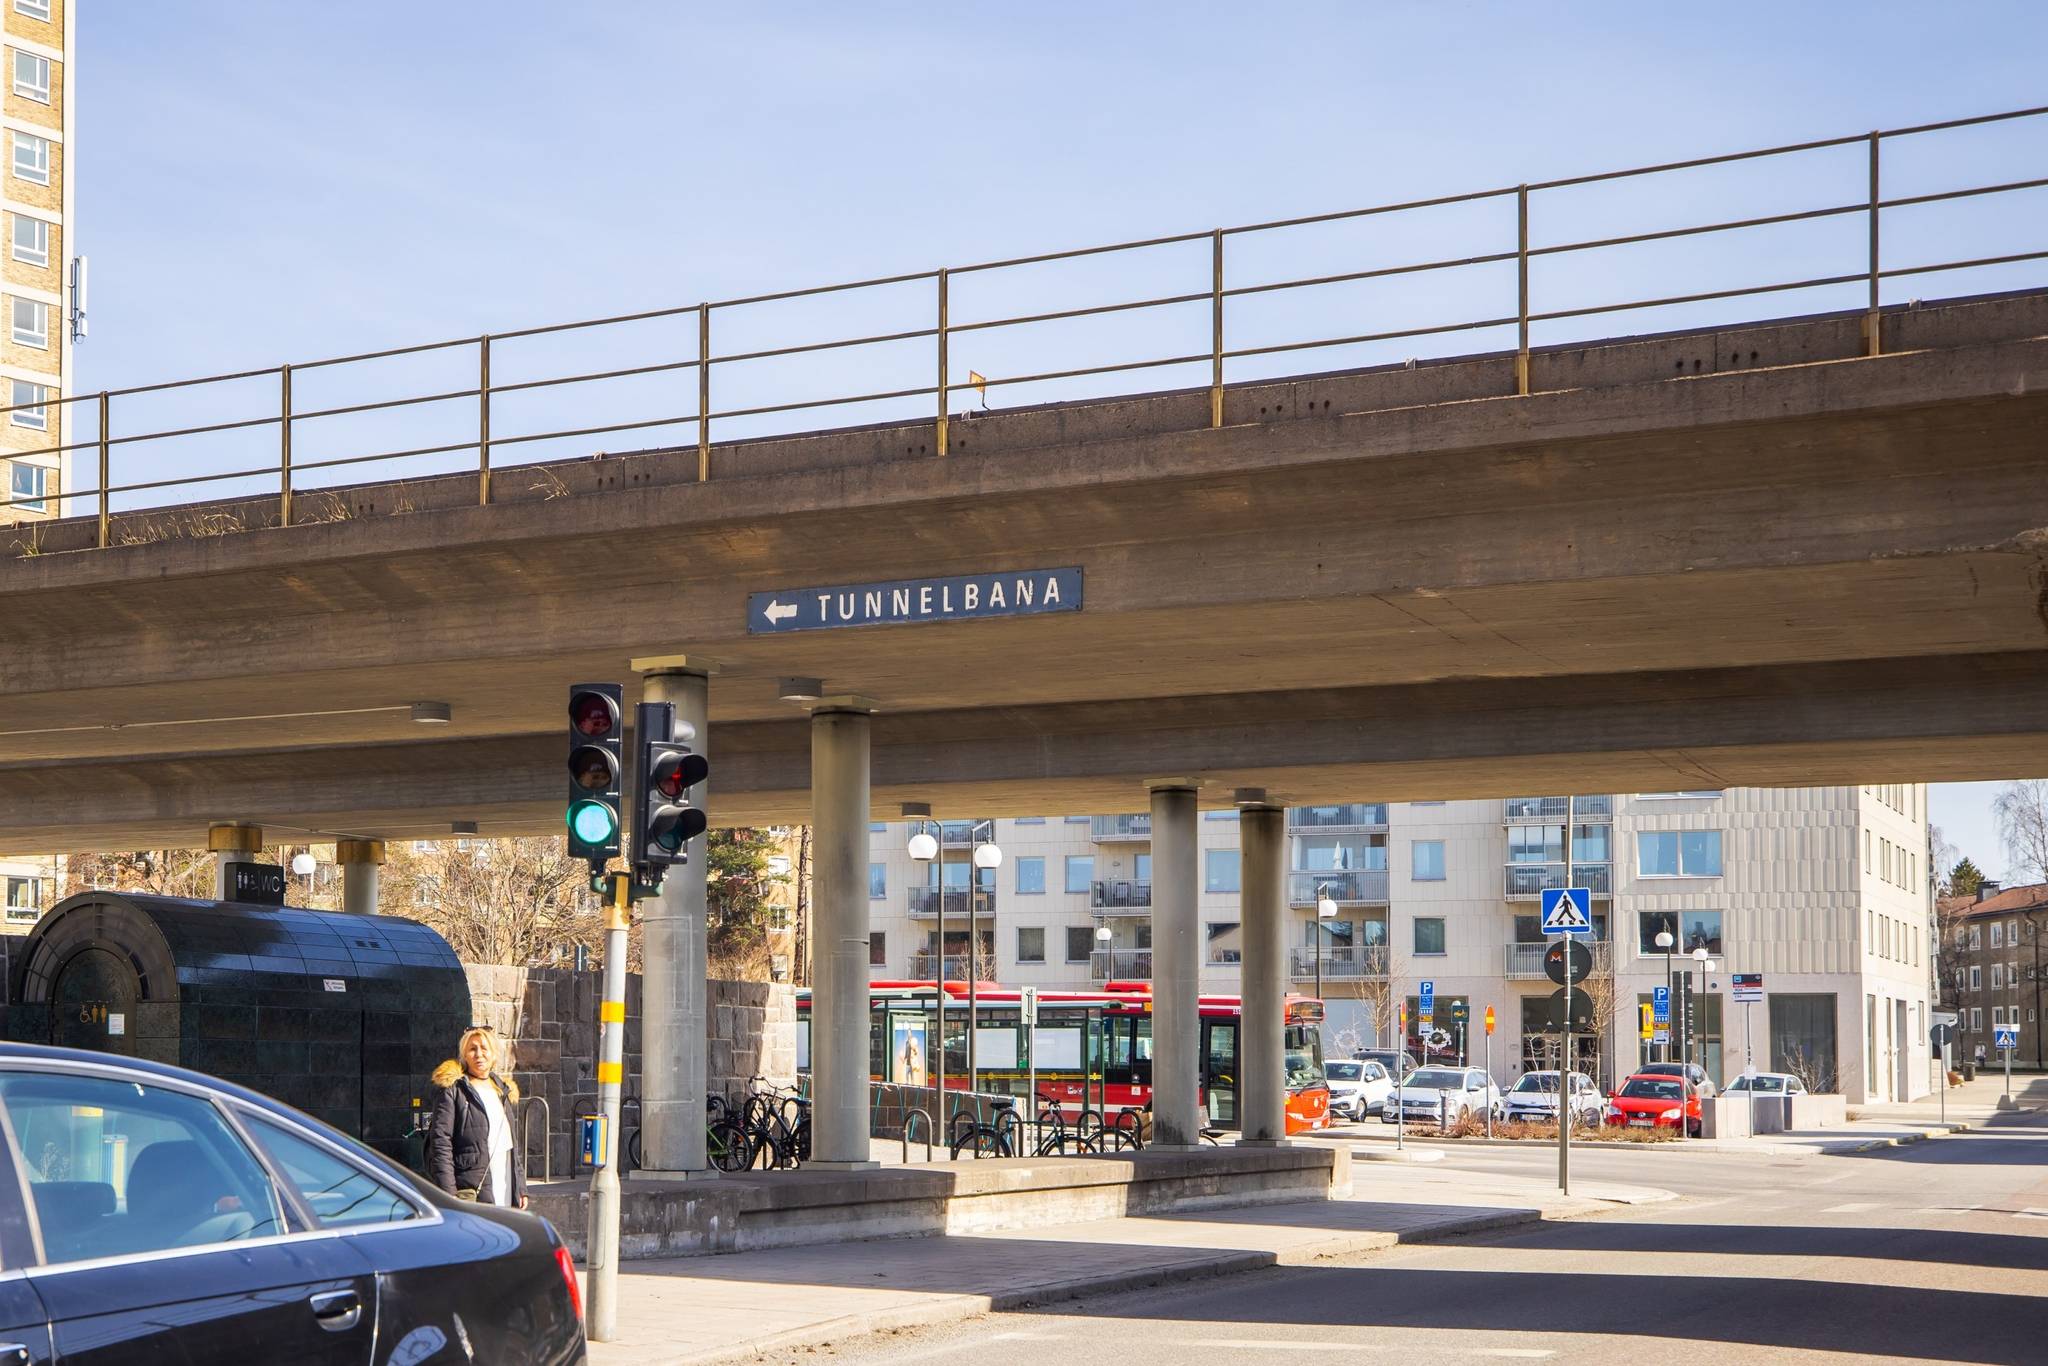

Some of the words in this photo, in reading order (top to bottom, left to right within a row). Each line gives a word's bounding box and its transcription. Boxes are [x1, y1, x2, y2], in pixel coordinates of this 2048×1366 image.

[817, 576, 1061, 622] TUNNELBANA
[261, 874, 280, 893] WC
[1423, 982, 1432, 994] P
[1657, 988, 1667, 1000] P
